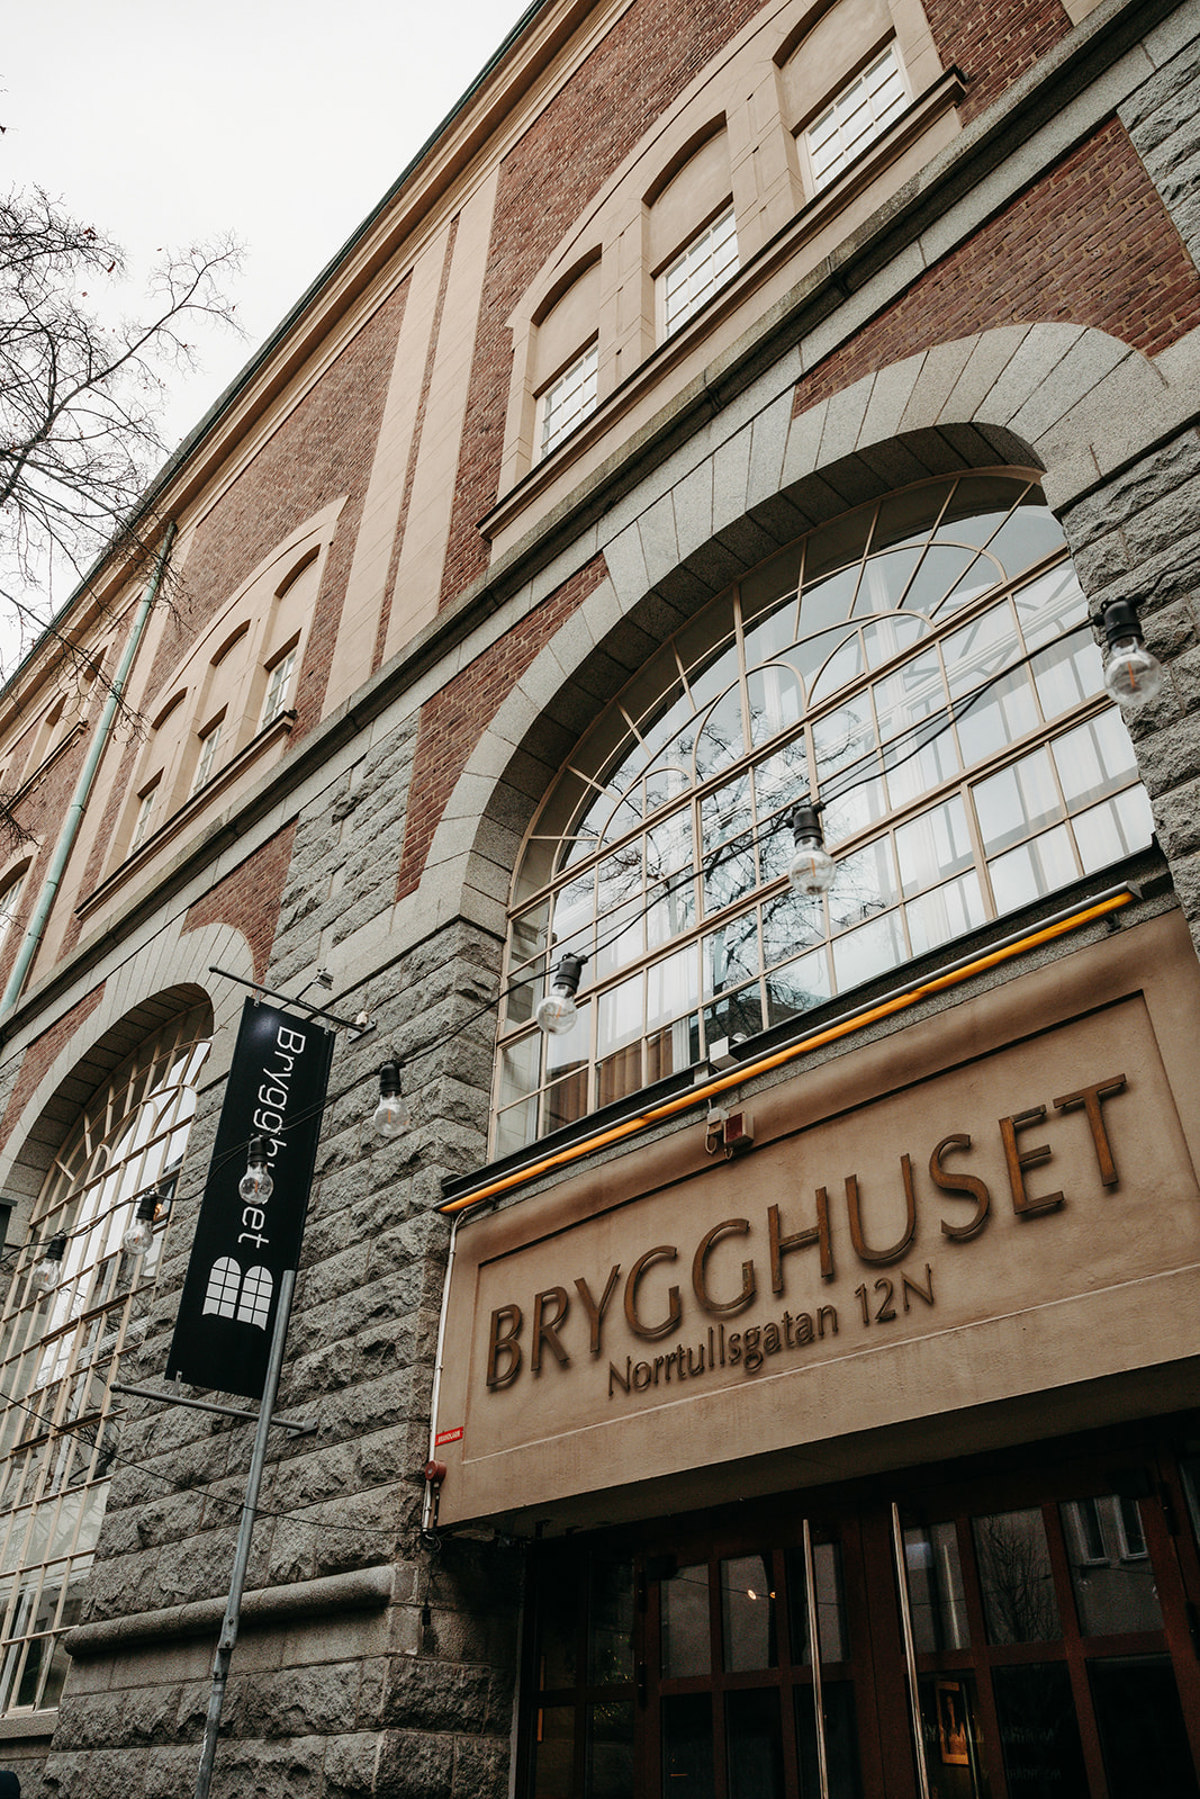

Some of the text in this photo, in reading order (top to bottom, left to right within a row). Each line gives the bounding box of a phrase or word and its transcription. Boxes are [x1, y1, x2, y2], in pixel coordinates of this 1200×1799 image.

[237, 1026, 306, 1249] Brygghet
[486, 1073, 1127, 1387] BRYGGHUSET
[608, 1262, 936, 1395] Norrtullsgatan 12N
